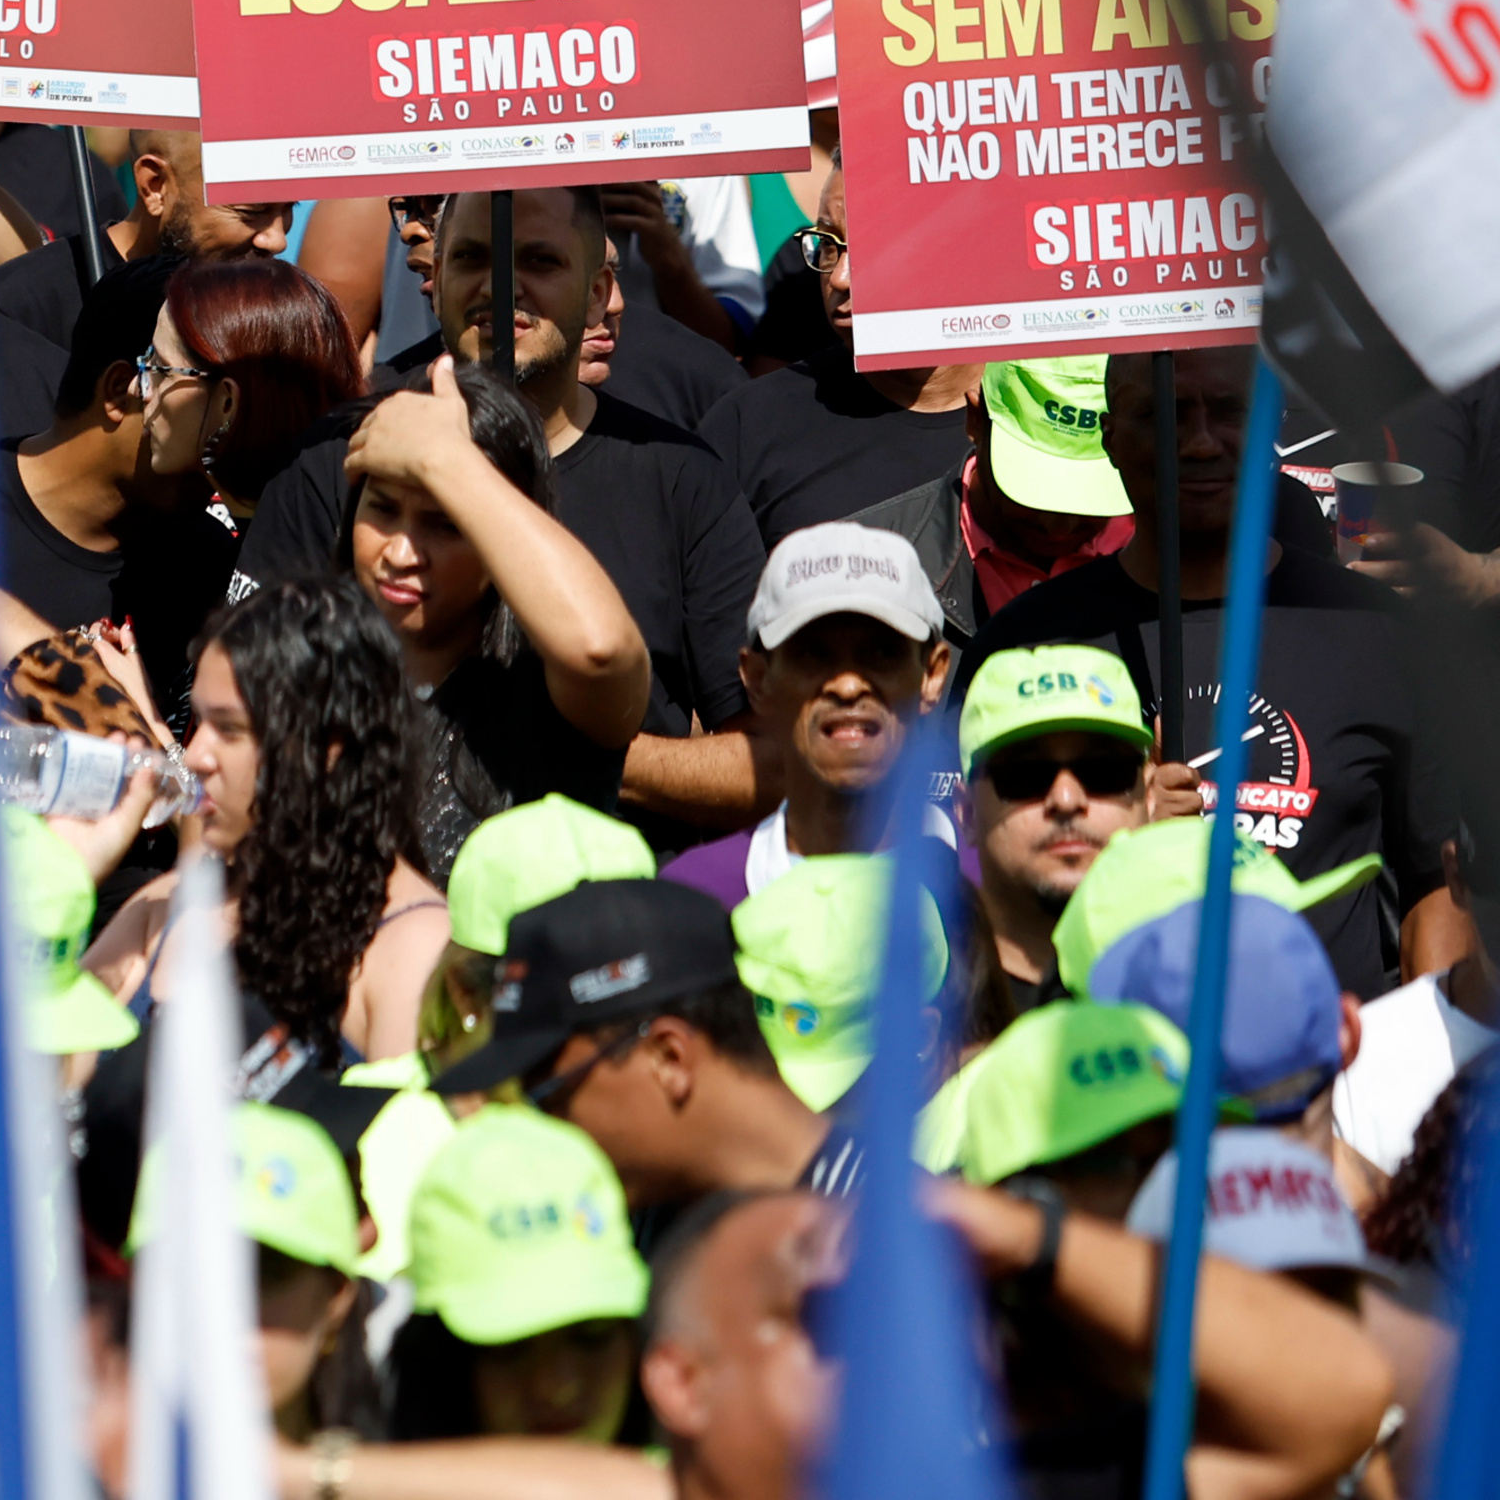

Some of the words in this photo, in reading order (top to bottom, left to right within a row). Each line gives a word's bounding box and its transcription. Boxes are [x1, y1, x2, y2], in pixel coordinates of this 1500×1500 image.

[376, 25, 637, 98] SIEMACO
[403, 97, 470, 124] SÃO
[498, 91, 616, 118] PAULO
[903, 74, 1039, 135] QUEM
[1051, 64, 1191, 119] TENTA
[289, 145, 356, 163] FEMACO
[368, 140, 452, 158] FENASCON
[461, 134, 544, 152] CONASCON
[650, 140, 685, 149] FONTES
[907, 122, 1001, 184] NÃO
[1015, 116, 1203, 177] MERECE
[1033, 192, 1270, 265] SIEMAC
[1060, 266, 1128, 291] SÃO
[1023, 307, 1110, 326] FENASCON
[1119, 300, 1204, 318] CONASCON
[942, 313, 1011, 332] FEMACO
[1044, 399, 1098, 429] CSB
[786, 555, 843, 589] New
[845, 554, 900, 584] York
[1018, 672, 1078, 699] CSB
